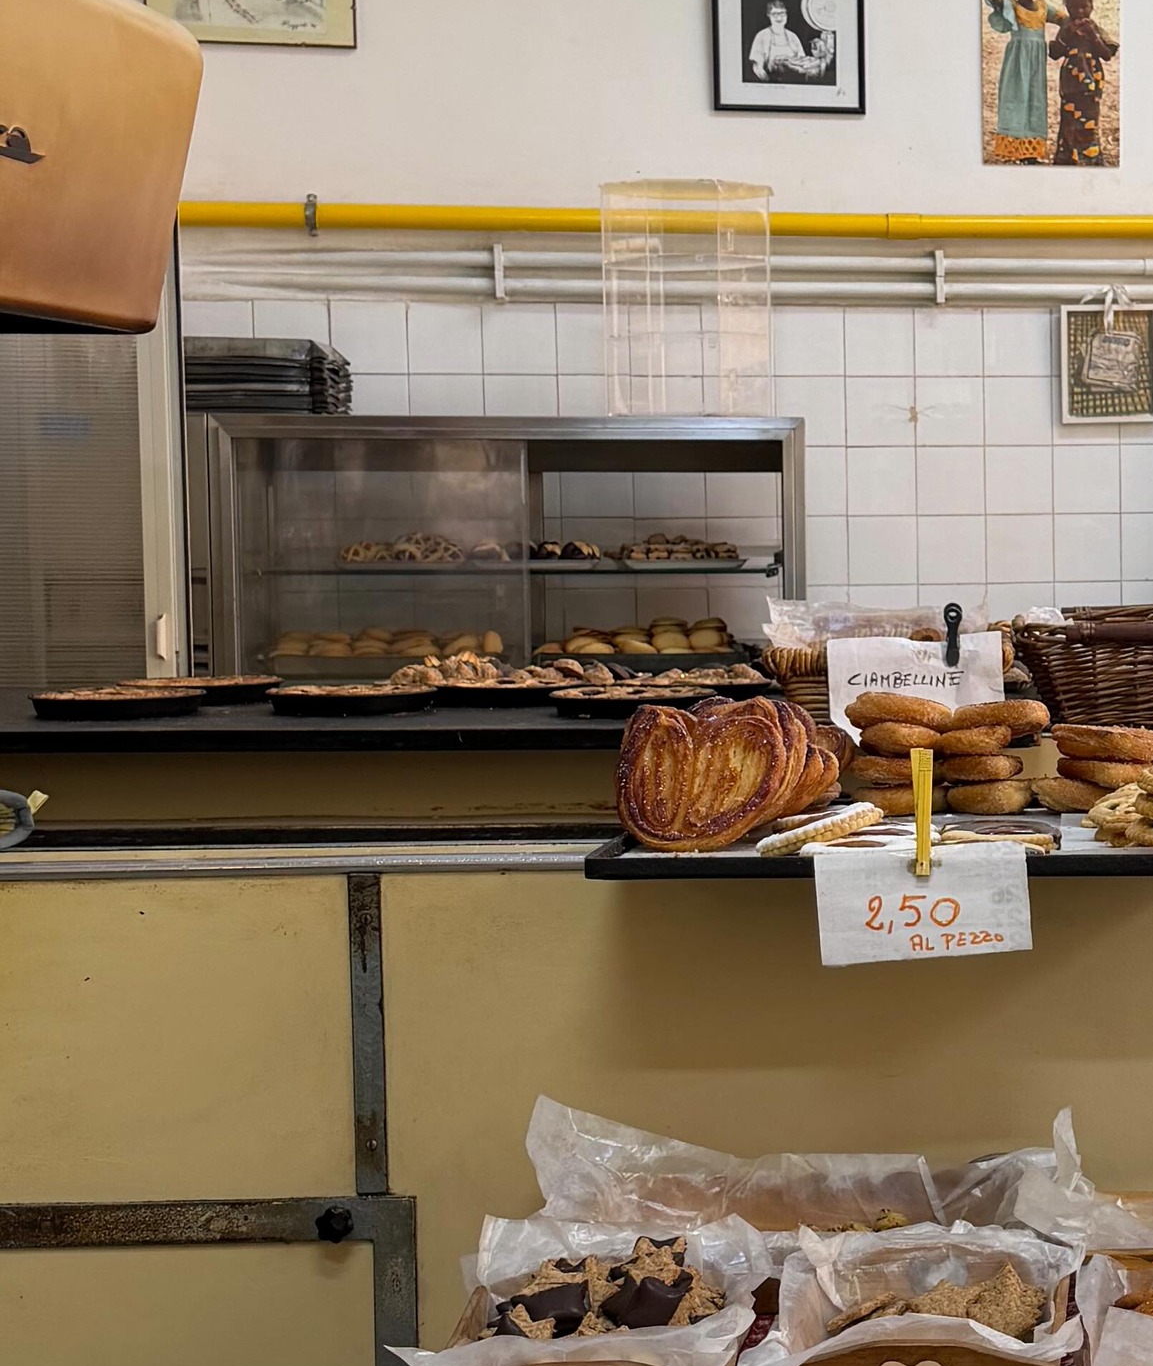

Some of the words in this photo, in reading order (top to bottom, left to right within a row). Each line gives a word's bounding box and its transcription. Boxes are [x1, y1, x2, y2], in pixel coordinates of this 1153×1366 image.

[847, 670, 965, 689] CIAMBELLINE
[864, 893, 961, 934] 2,50
[908, 933, 935, 952] AL
[940, 930, 1005, 951] PEZZO
